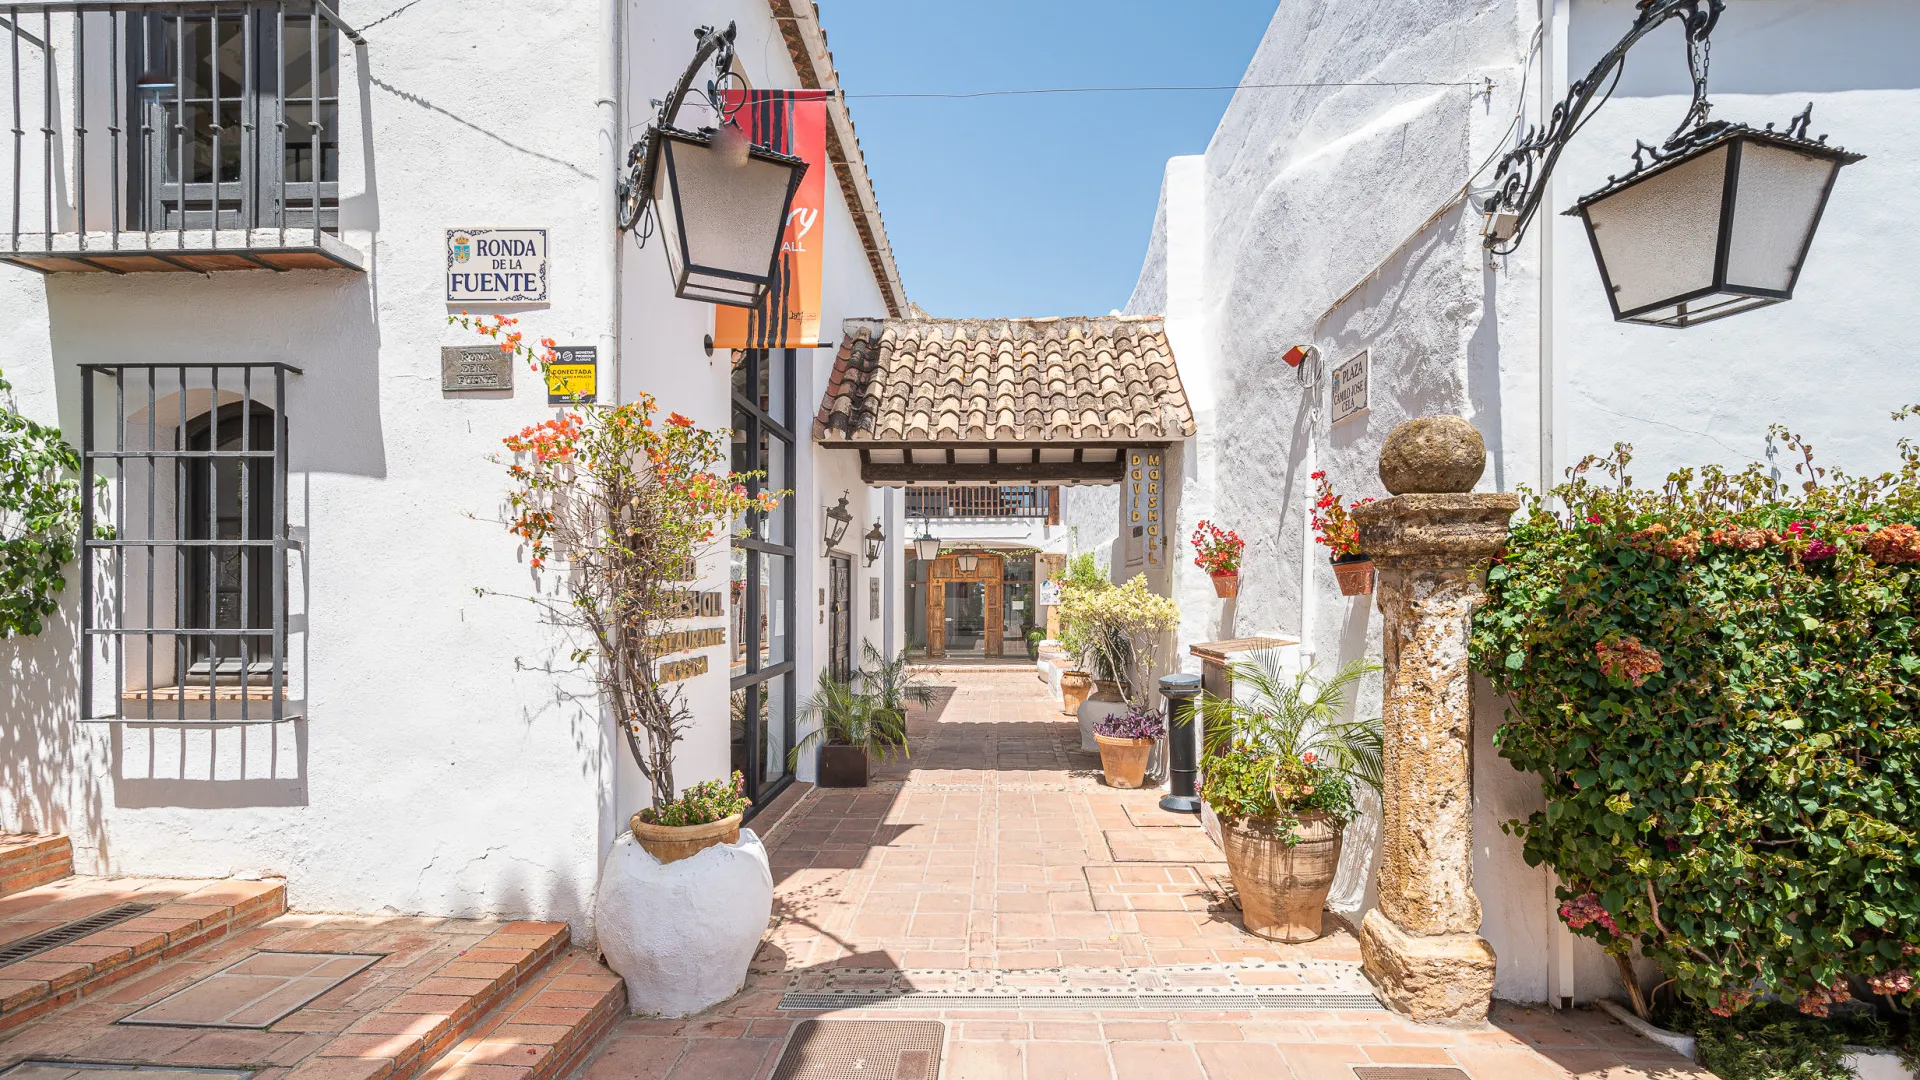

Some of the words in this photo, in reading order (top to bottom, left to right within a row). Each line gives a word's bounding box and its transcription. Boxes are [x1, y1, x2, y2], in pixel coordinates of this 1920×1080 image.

[476, 239, 537, 257] RONDA
[492, 259, 507, 270] DE
[509, 259, 522, 270] LA
[451, 273, 537, 292] FUENTE
[460, 351, 497, 362] RONDA
[461, 363, 476, 373] DE
[477, 363, 492, 373] LA
[1343, 361, 1362, 384] PLAZA
[457, 374, 498, 385] FUENTE
[1341, 398, 1355, 412] CELA
